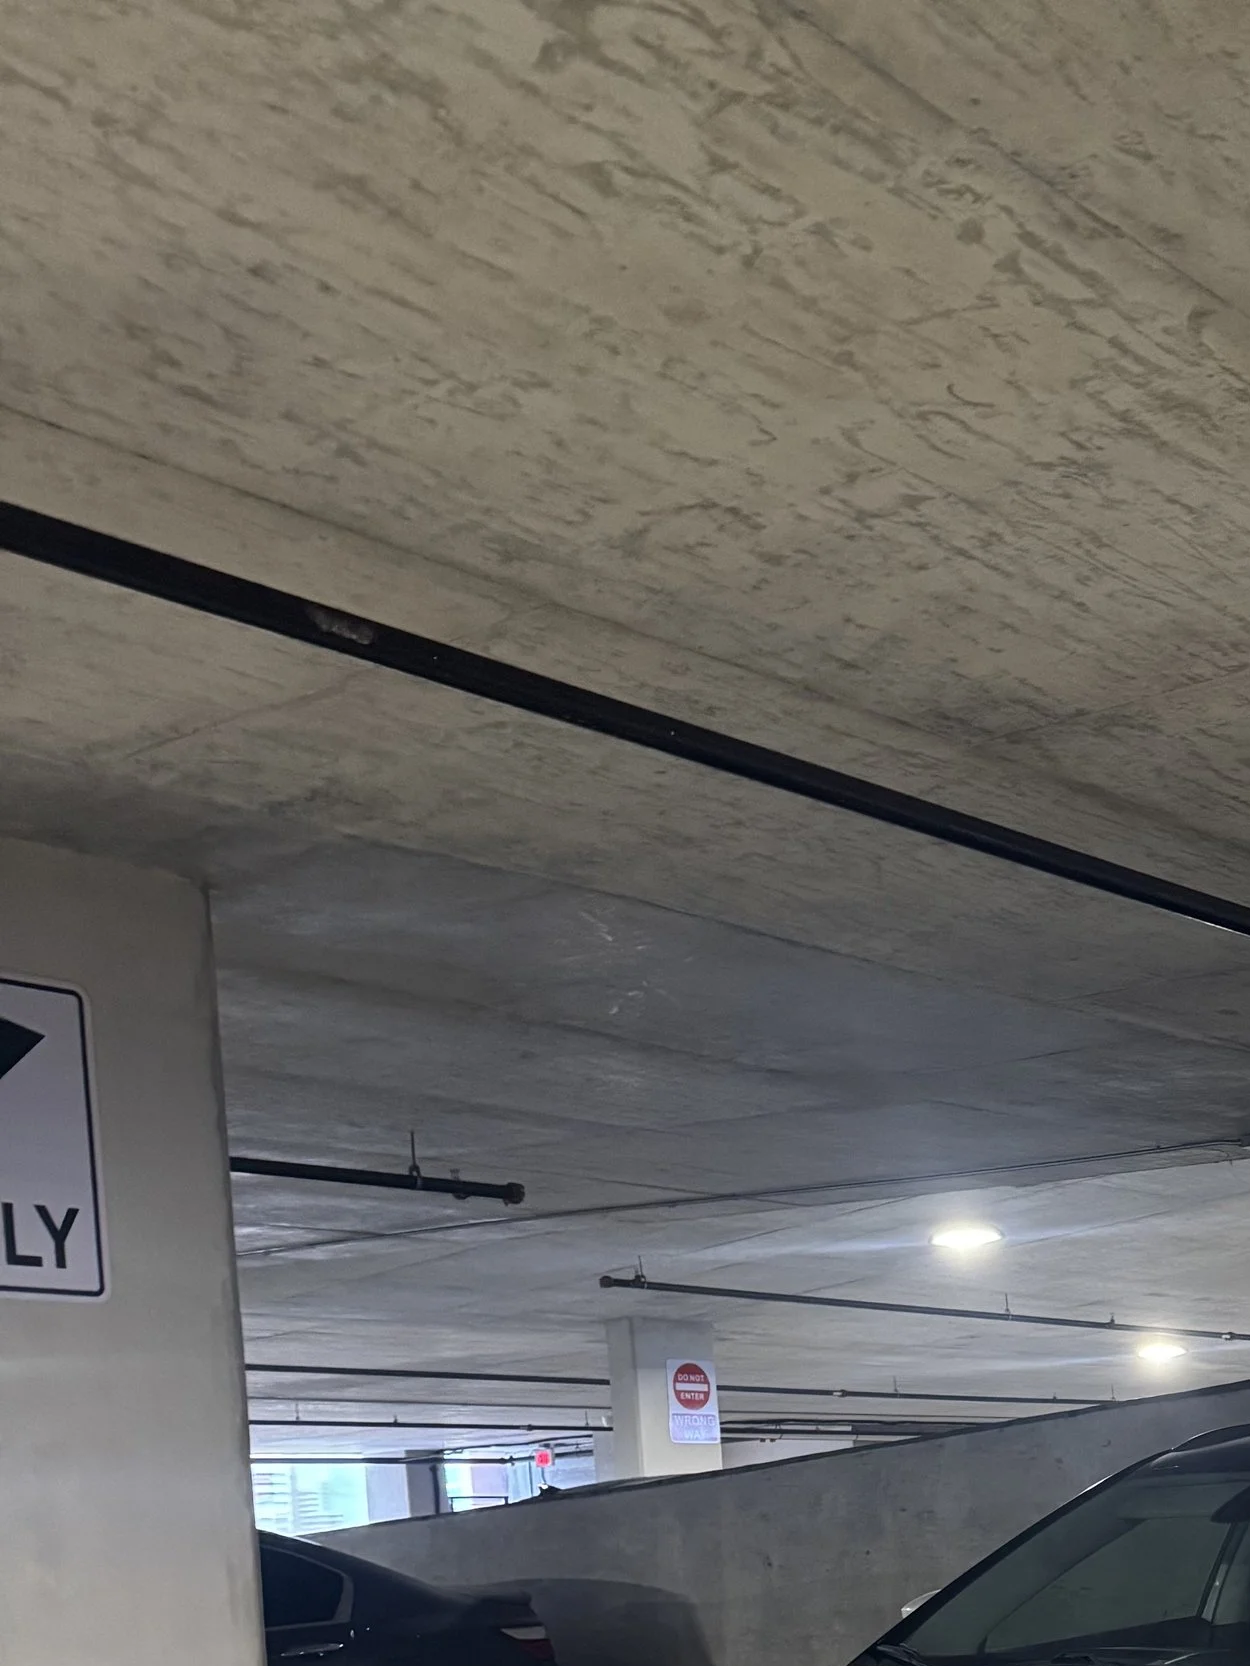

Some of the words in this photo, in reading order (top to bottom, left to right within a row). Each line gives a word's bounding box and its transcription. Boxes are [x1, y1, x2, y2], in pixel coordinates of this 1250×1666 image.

[690, 1374, 705, 1382] NOT
[680, 1392, 705, 1400] ENTER
[674, 1415, 716, 1427] WRONG
[684, 1429, 708, 1440] WAY
